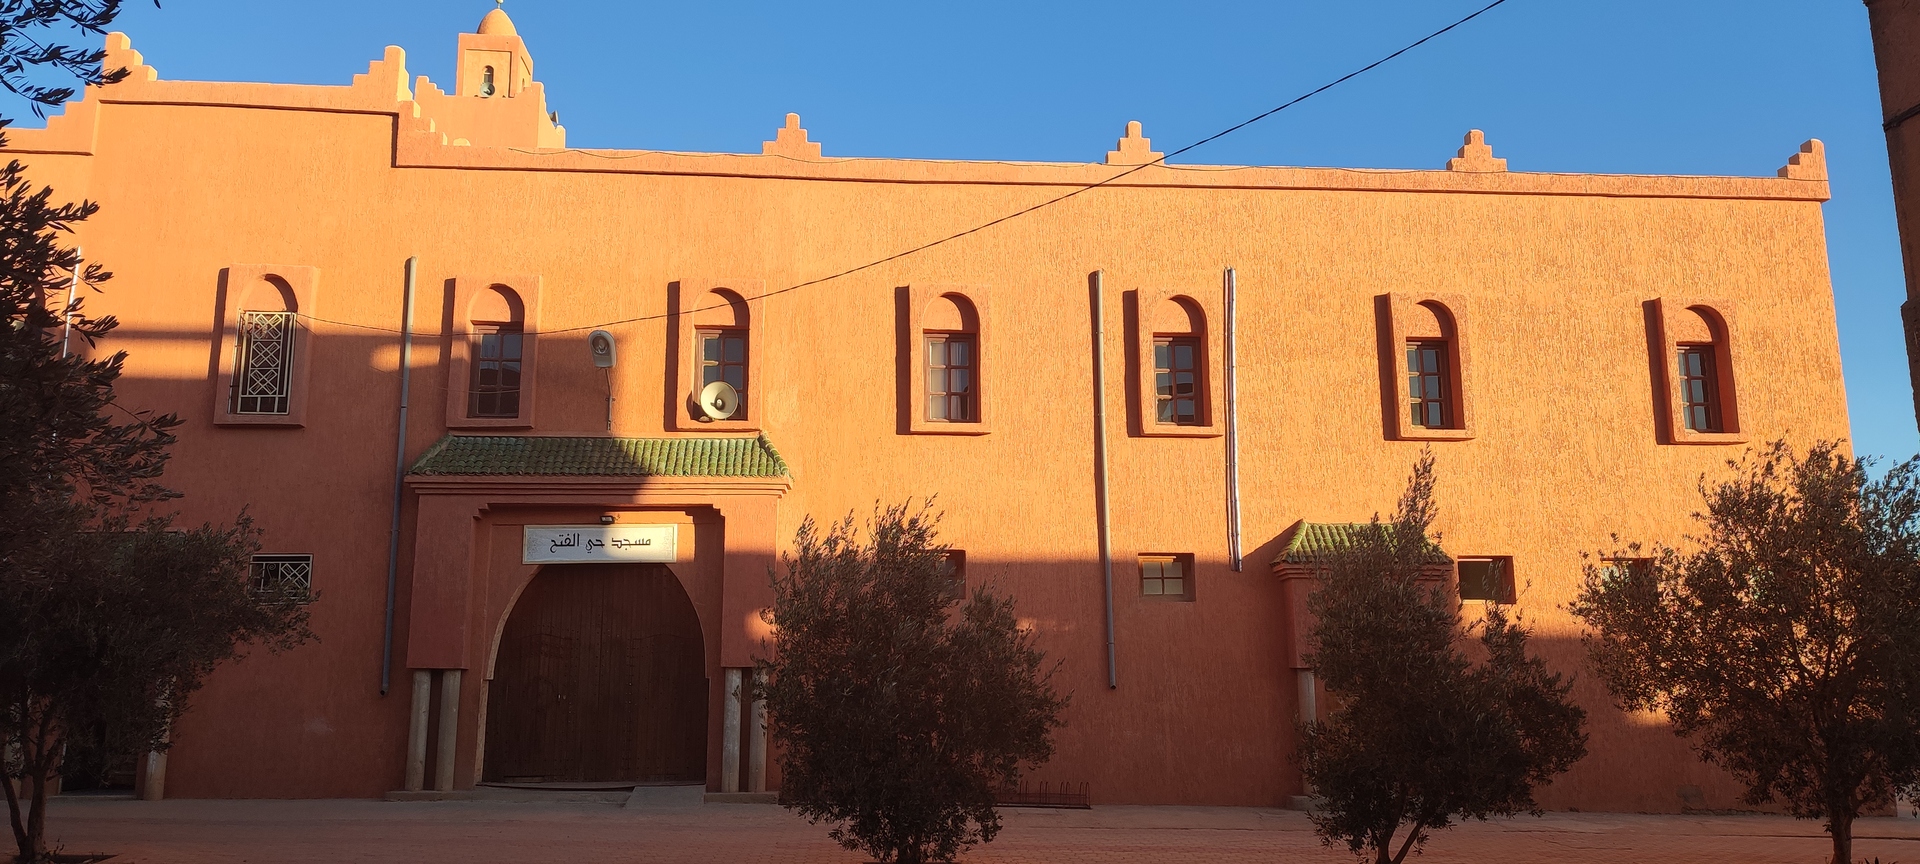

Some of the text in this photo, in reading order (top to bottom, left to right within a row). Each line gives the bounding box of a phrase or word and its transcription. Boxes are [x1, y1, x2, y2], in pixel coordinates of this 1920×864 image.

[549, 532, 651, 554] مسجد حي الفتح
